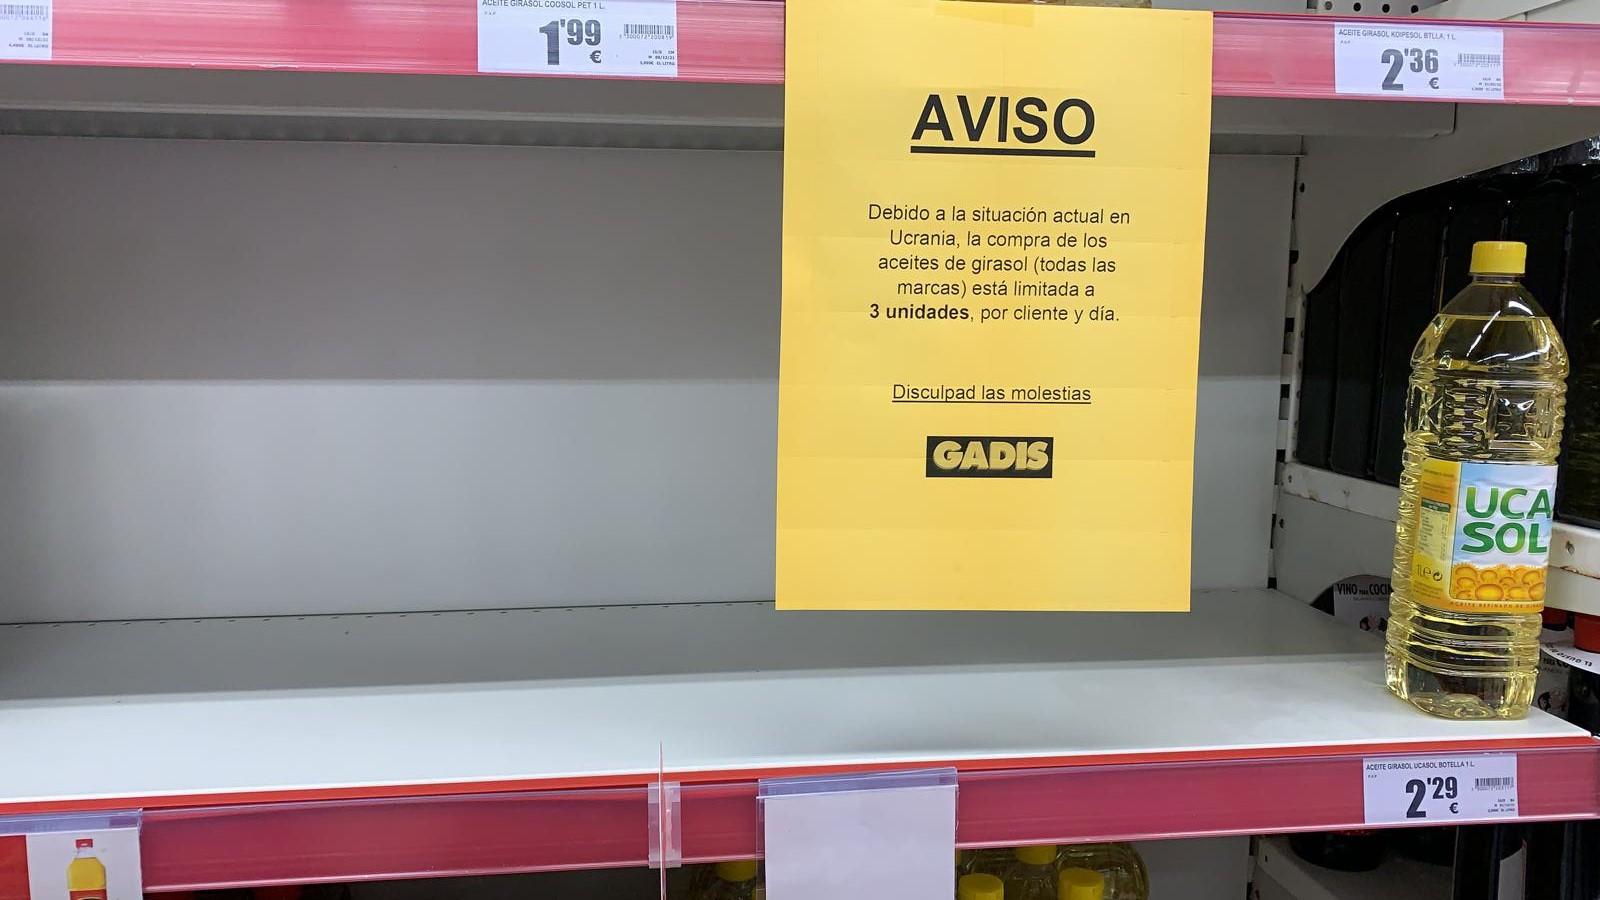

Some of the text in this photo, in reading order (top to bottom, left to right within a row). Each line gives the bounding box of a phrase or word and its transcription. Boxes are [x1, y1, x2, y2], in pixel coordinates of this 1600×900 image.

[1362, 30, 1389, 38] GIRASOL
[1391, 31, 1422, 39] KOIPESOL
[590, 50, 602, 64] €
[1381, 48, 1439, 91] 2'36
[1429, 77, 1439, 89] €
[911, 94, 1094, 144] AVISO
[868, 204, 1130, 224] Debido a la situación actual en
[890, 229, 1107, 251] Ucrania, la compra de los
[878, 254, 1116, 274] aceites de girasol (todas las
[897, 280, 1094, 298] marcas) está limitada a
[870, 304, 1120, 324] 3 unidades, por cliente y día.
[893, 384, 1091, 402] Disculpad las molestias
[933, 440, 1049, 471] GADIS
[1466, 486, 1550, 519] UCA
[1461, 522, 1547, 554] SOL
[1337, 584, 1357, 595] VINO
[1406, 776, 1458, 818] 2'29
[1449, 802, 1459, 814] €
